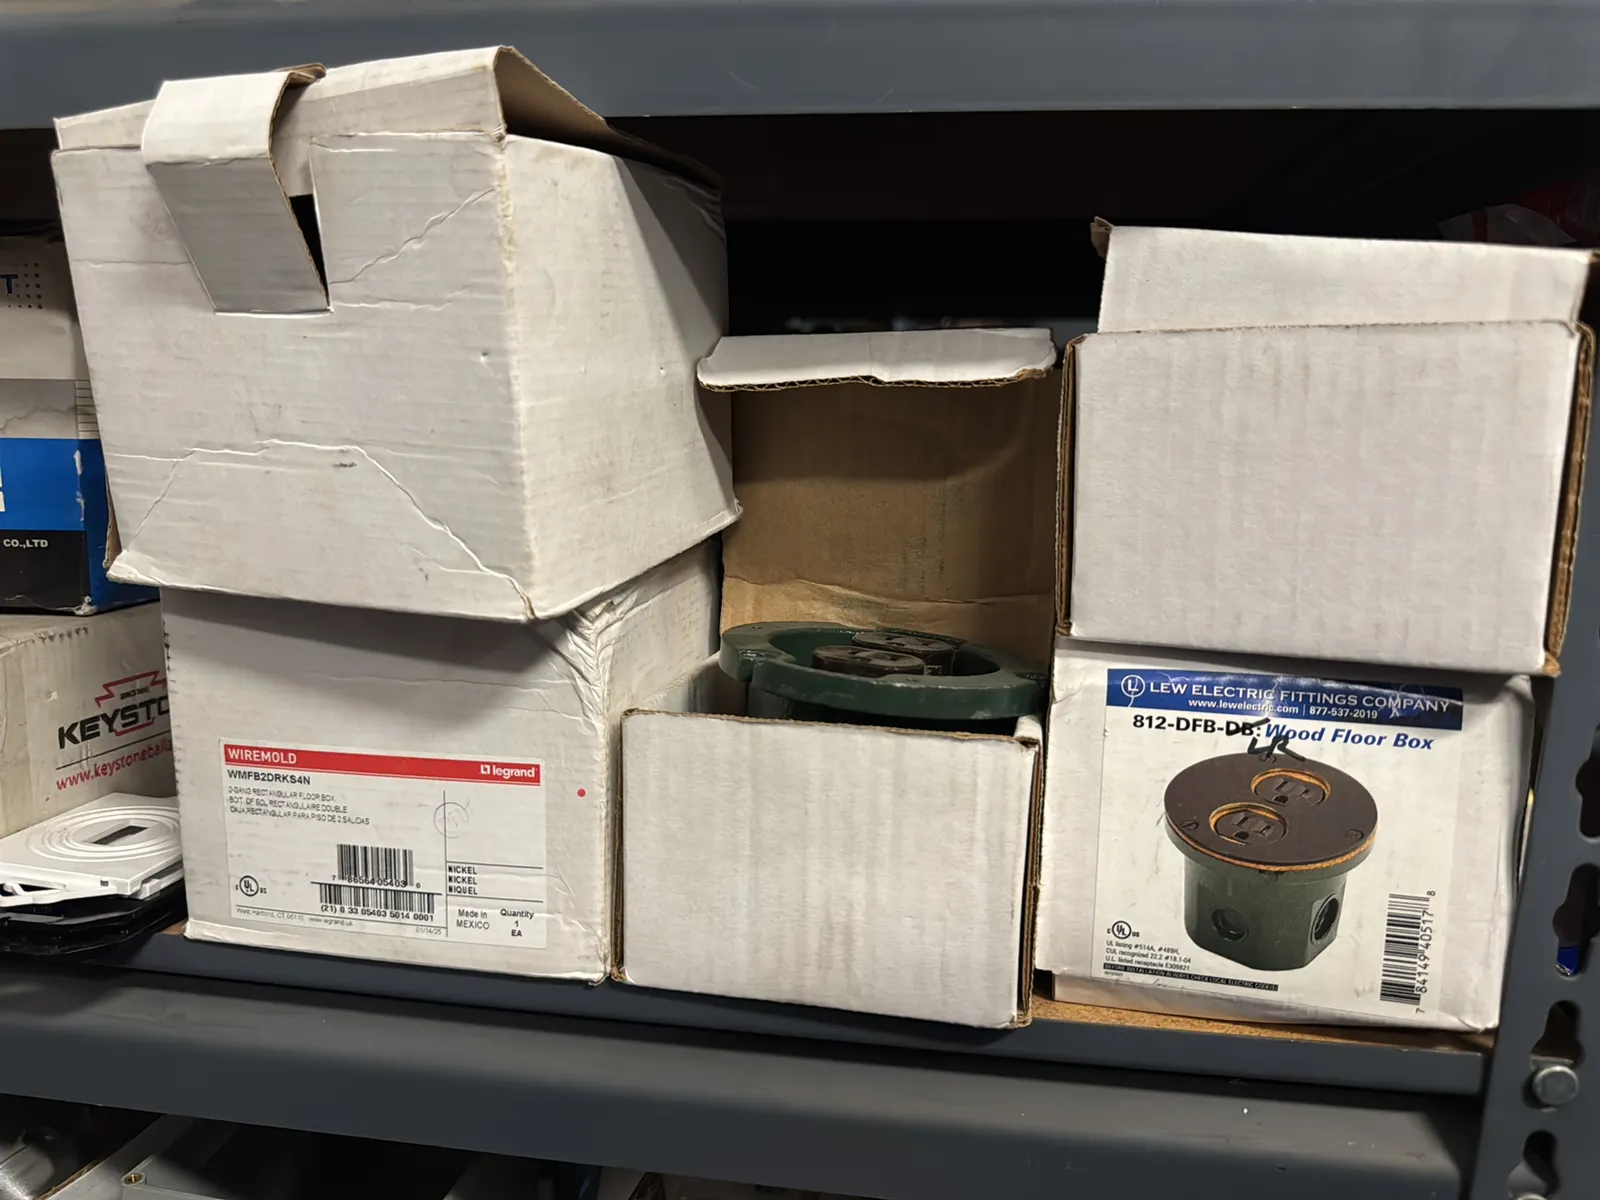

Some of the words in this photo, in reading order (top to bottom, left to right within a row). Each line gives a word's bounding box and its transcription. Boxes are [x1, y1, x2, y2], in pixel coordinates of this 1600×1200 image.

[3, 539, 49, 549] CO.,LTD
[1150, 682, 1187, 695] LEW
[1192, 684, 1275, 700] ELECTRIC
[1280, 690, 1358, 706] FITTINGS
[1362, 695, 1450, 713] COMPANY
[1188, 699, 1299, 714] www.lewelectric.com
[1309, 706, 1378, 719] 877-537-2019
[1265, 723, 1326, 742] Wood
[1330, 728, 1388, 746] Floor
[1392, 733, 1436, 750] Box
[227, 748, 298, 765] WIREMOLD
[227, 769, 312, 786] WMFB2DRKS4N
[492, 765, 536, 780] legrand
[252, 787, 297, 799] RECTANGULAR
[298, 791, 321, 801] FLOOR
[321, 793, 336, 802] BOX
[255, 798, 268, 807] SOL
[322, 804, 348, 814] DOUBLE
[246, 807, 292, 818] RECTANGULAR
[292, 811, 310, 820] PARA
[310, 813, 327, 822] PISO
[327, 814, 337, 823] DE
[342, 815, 370, 825] SALIDAS
[447, 866, 477, 875] NICKEL
[347, 876, 376, 885] 86564
[377, 878, 407, 888] 05403
[448, 876, 478, 885] NICKEL
[448, 885, 478, 895] NIQUEL
[320, 904, 337, 914] (21)
[340, 906, 345, 914] 0
[348, 906, 359, 915] 33
[361, 908, 387, 918] 05403
[389, 910, 410, 920] 5014
[413, 912, 434, 922] 0001
[458, 909, 479, 918] Made
[481, 909, 488, 919] in
[500, 908, 535, 920] Quantity
[415, 927, 442, 935] 01/14/25
[456, 919, 490, 930] MEXICO
[1419, 909, 1434, 950] 40517
[1115, 941, 1133, 950] listing
[1118, 949, 1149, 959] recognized
[1117, 956, 1133, 964] listed
[1134, 959, 1163, 968] receptacle
[1165, 970, 1189, 979] ALWAYS
[1190, 974, 1208, 982] CHECK
[1209, 976, 1226, 984] LOCAL
[1228, 979, 1254, 987] ELECTRIC
[1415, 954, 1430, 994] 84149
